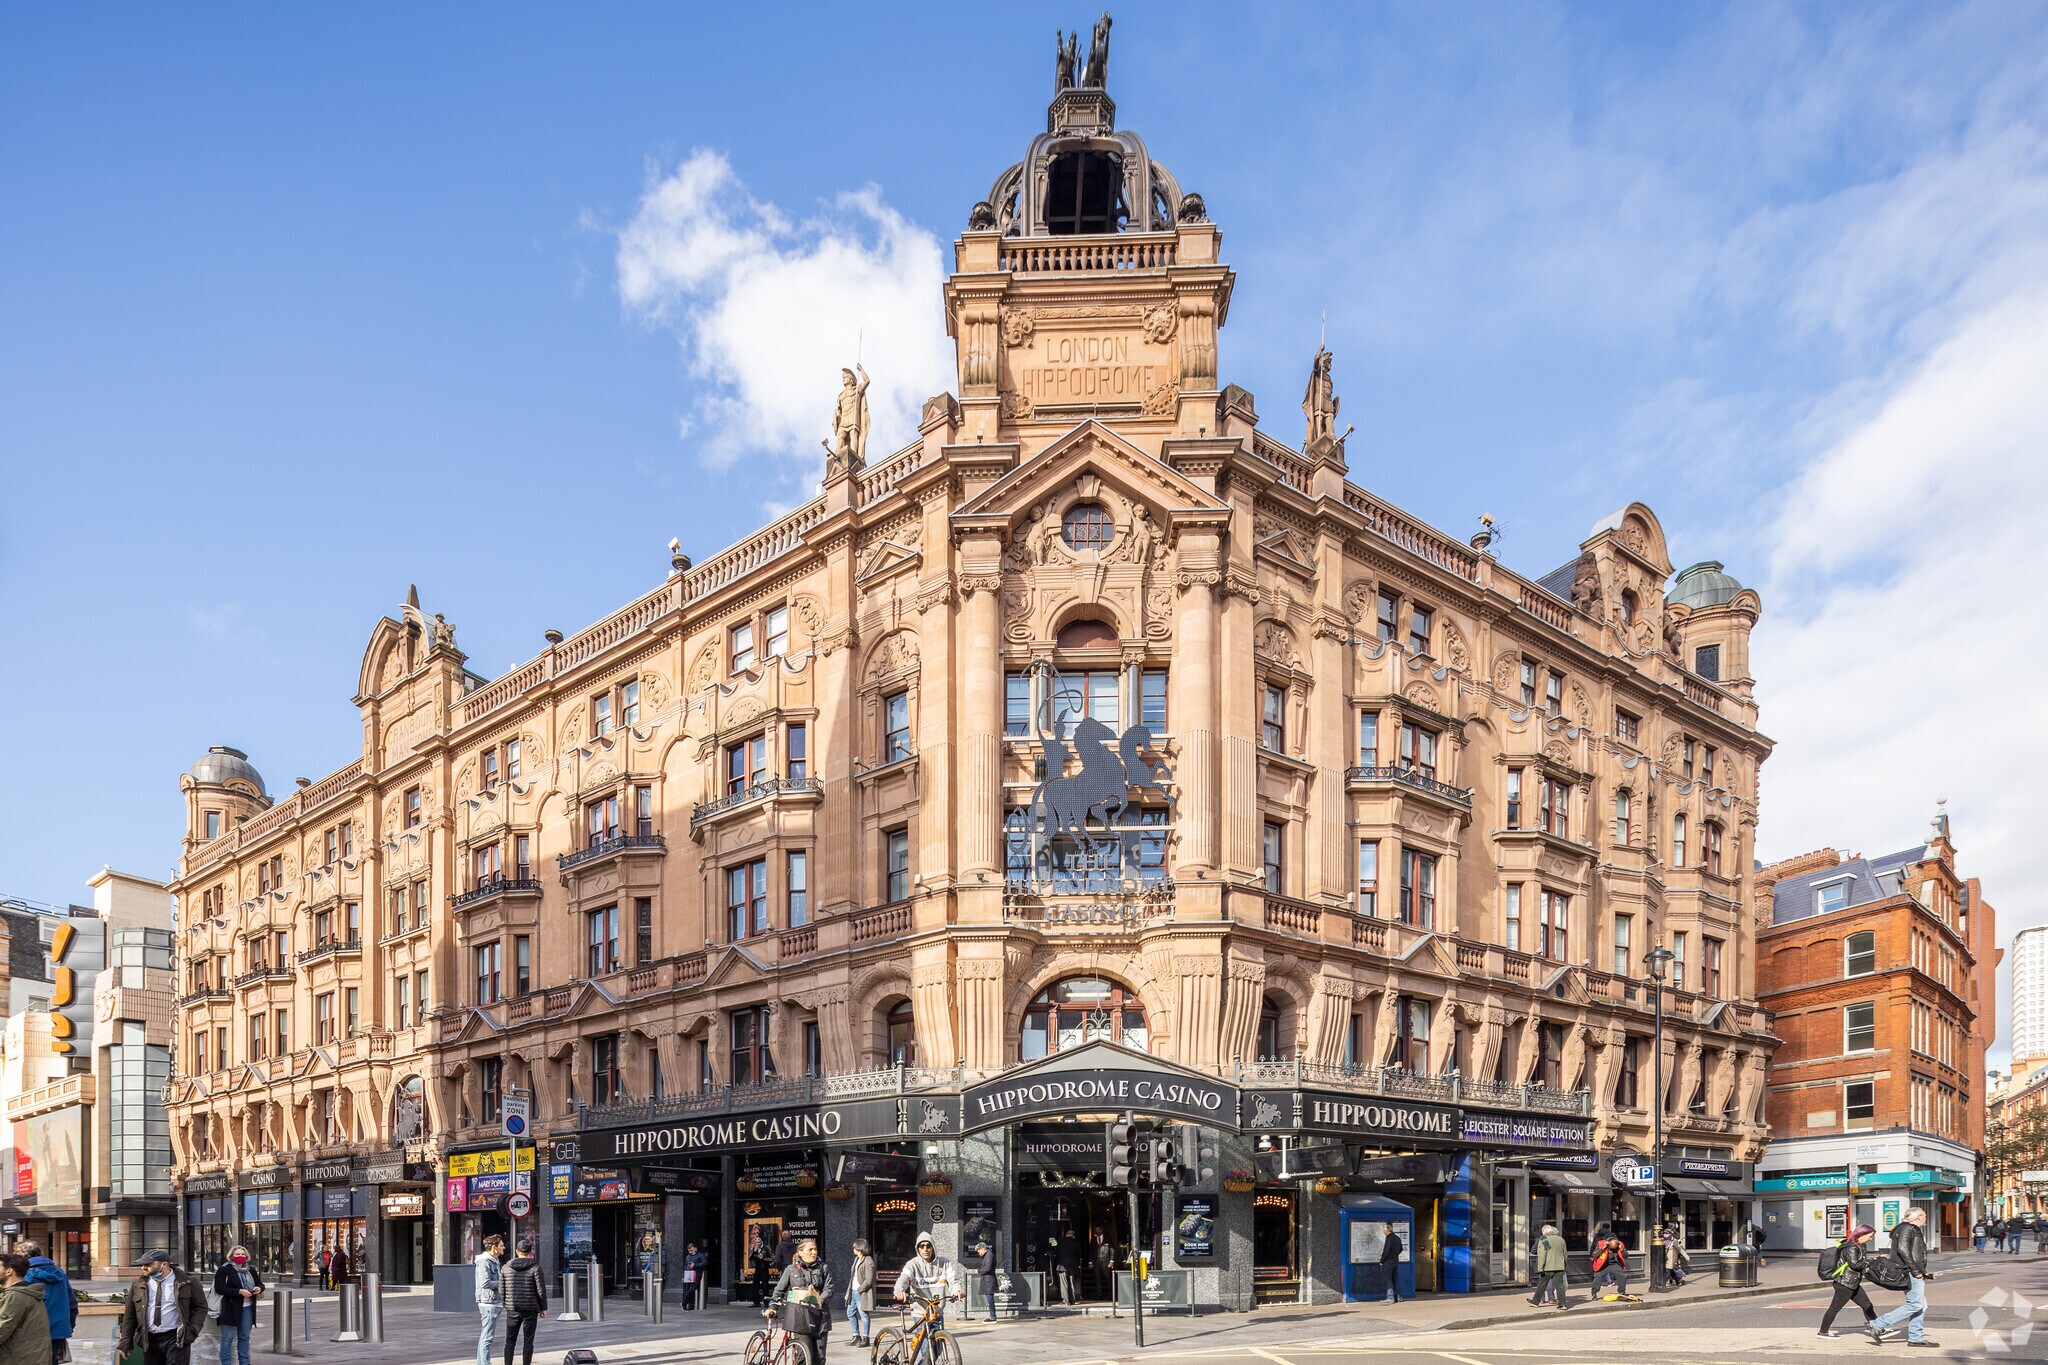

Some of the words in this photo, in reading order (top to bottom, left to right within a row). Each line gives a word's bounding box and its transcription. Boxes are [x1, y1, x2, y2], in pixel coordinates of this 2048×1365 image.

[1047, 337, 1129, 363] LONDON
[1023, 366, 1154, 397] HIPPODROME
[1067, 853, 1114, 871] THE
[1005, 876, 1175, 896] HIPPODROME
[1044, 903, 1138, 922] CASINO
[978, 1080, 1130, 1116] HIPPODROME
[1134, 1081, 1223, 1111] CASINO
[1313, 1100, 1452, 1133] HIPPODROME
[615, 1121, 747, 1155] HIPPODROME
[752, 1111, 842, 1142] CASINO
[1464, 1120, 1509, 1136] LEICESTER
[1512, 1125, 1547, 1138] SQUARE
[1550, 1127, 1584, 1141] STATION
[1026, 1143, 1103, 1154] HIPPODROME
[518, 1153, 529, 1165] KING
[351, 1167, 401, 1181] HIPPODROME
[1642, 1169, 1651, 1179] P
[1684, 1162, 1726, 1172] PIZZAEXPRESS
[187, 1178, 227, 1192] HIPPODROME
[252, 1172, 276, 1185] CASINO
[478, 1179, 491, 1189] MARY
[491, 1177, 509, 1188] POPPINS
[554, 1175, 569, 1183] COME
[875, 1200, 916, 1213] CASINO
[1253, 1195, 1289, 1207] ASINO
